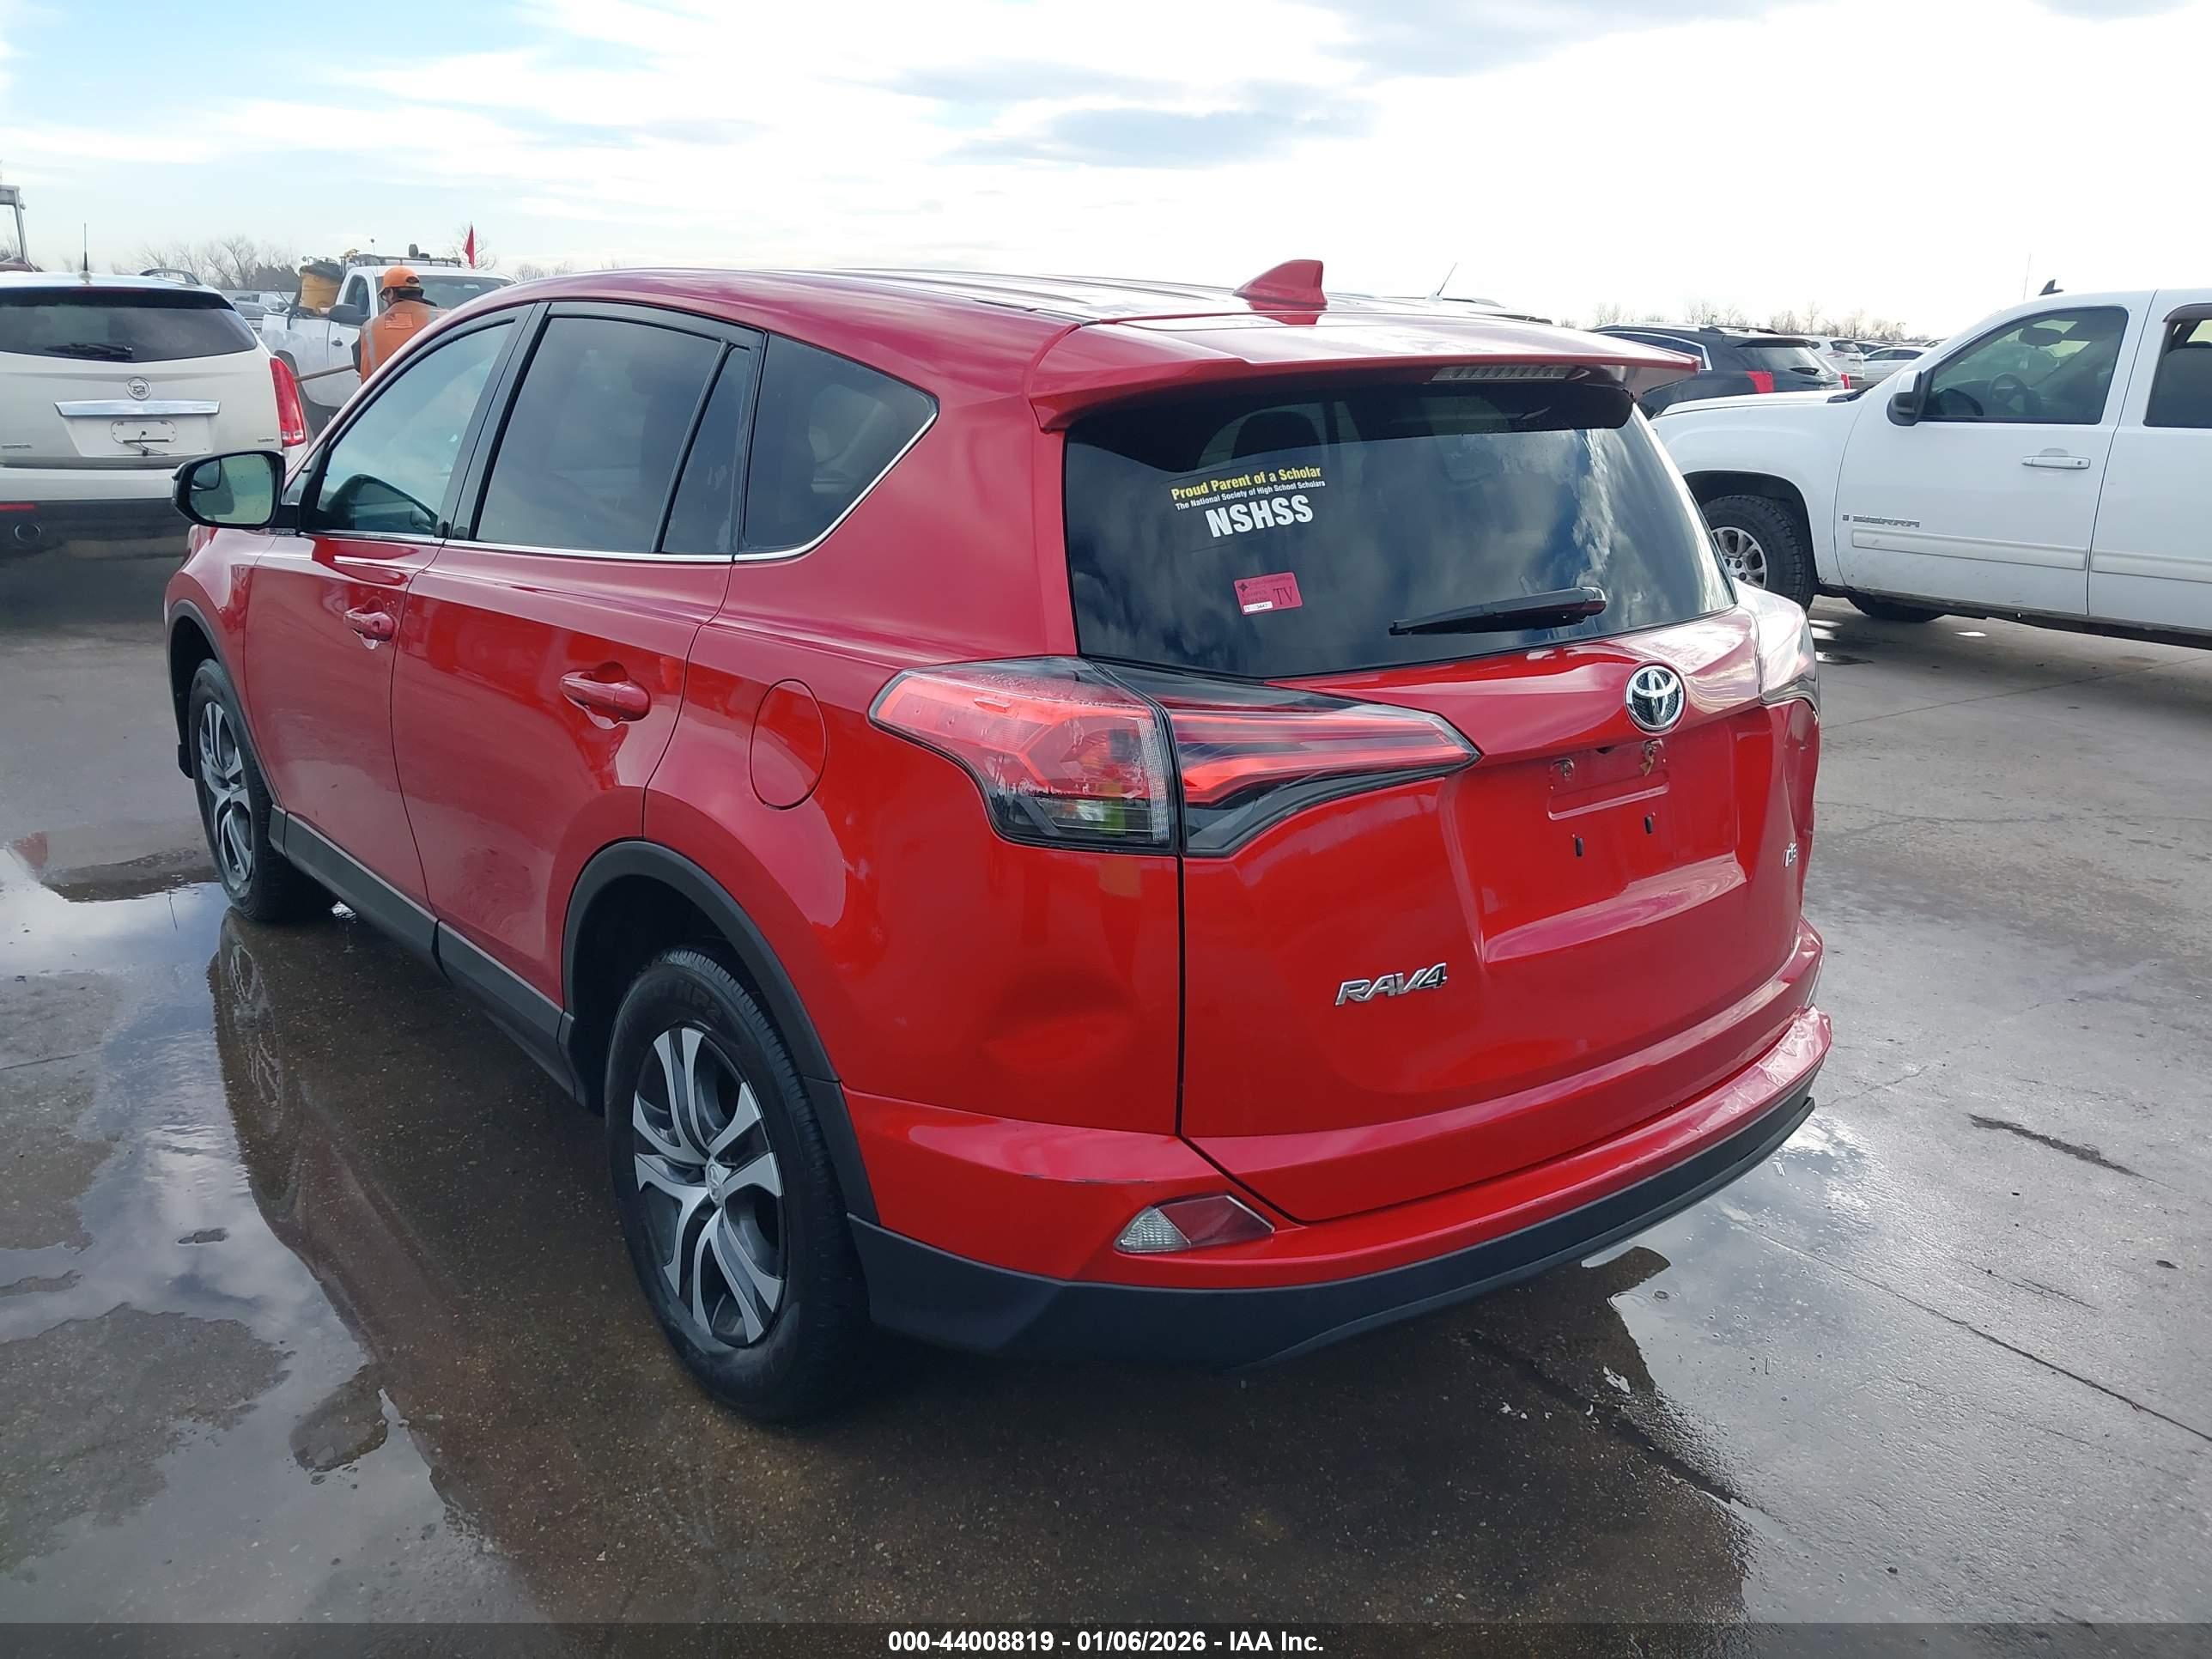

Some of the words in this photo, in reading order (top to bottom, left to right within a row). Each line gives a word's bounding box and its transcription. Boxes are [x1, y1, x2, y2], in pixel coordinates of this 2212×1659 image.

[1170, 483, 1209, 501] Proud
[1210, 474, 1252, 490] Parent
[1254, 471, 1267, 485] of
[1268, 472, 1277, 483] a
[1278, 466, 1322, 479] Scholar
[1175, 501, 1190, 511] The
[1190, 492, 1221, 507] National
[1221, 489, 1248, 501] Society
[1249, 488, 1256, 496] of
[1256, 485, 1273, 495] High
[1273, 481, 1297, 492] School
[1297, 478, 1326, 489] Scholars
[1205, 495, 1313, 538] NSHSS
[1272, 586, 1292, 605] TV
[1334, 962, 1448, 1006] RAV4
